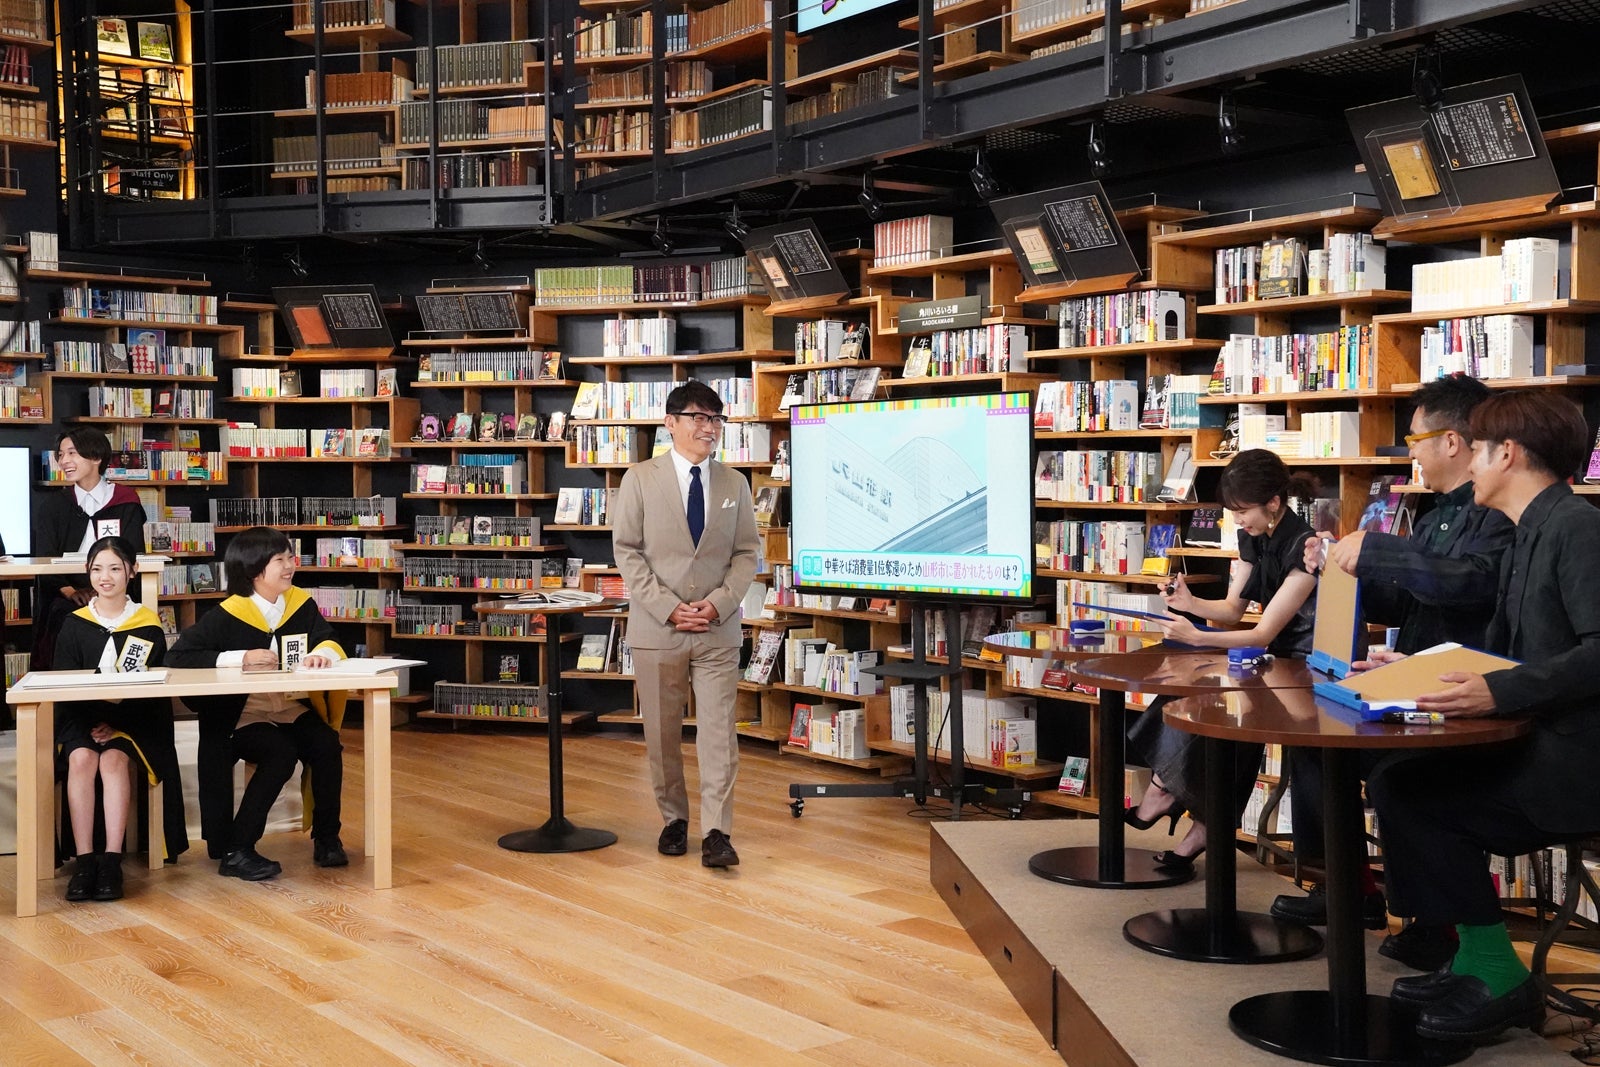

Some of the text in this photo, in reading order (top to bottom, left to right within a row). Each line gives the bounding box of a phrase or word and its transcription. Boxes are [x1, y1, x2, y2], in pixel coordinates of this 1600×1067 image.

[1451, 158, 1460, 168] 8
[153, 171, 174, 182] Only
[102, 524, 113, 536] 大
[1191, 520, 1214, 529] 水族館
[287, 641, 300, 666] 岡部
